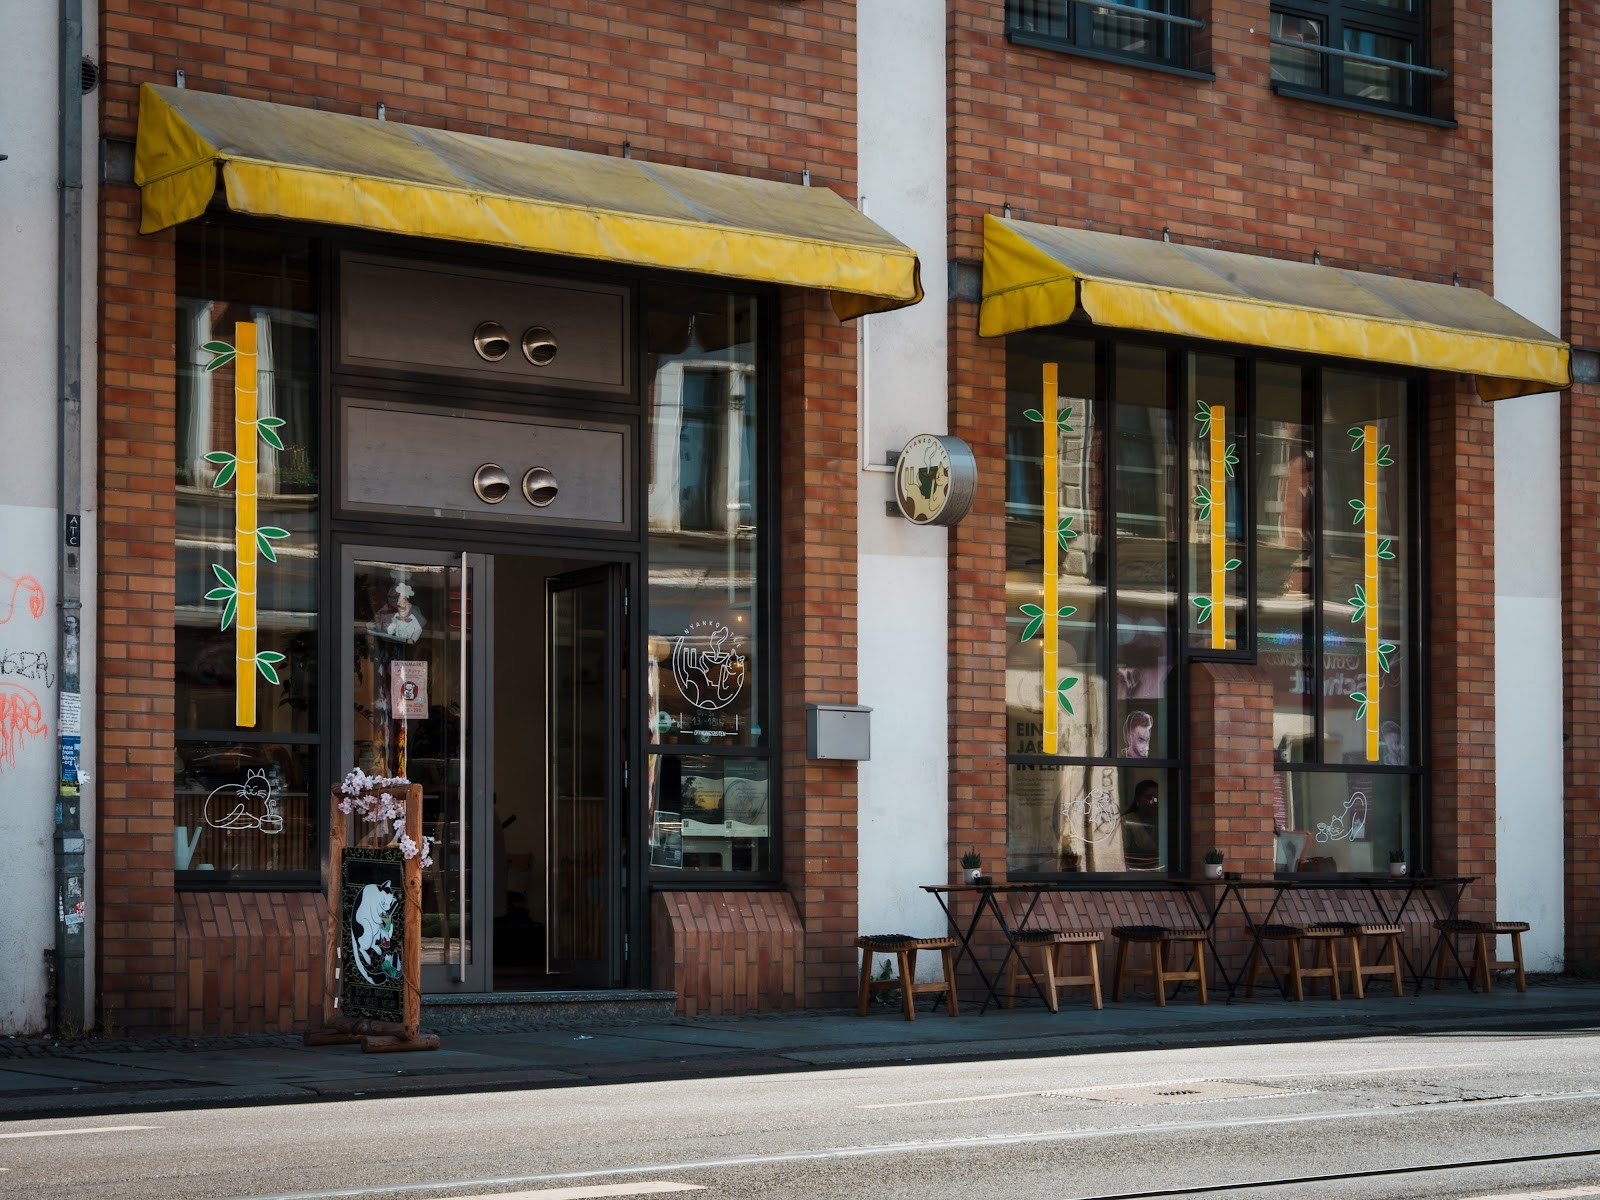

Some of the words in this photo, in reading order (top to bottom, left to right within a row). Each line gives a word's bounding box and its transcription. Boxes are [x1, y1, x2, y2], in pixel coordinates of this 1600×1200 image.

[905, 438, 931, 454] NYANKO
[938, 445, 947, 460] TEE
[69, 515, 77, 545] ATC
[683, 620, 720, 635] NYANKO
